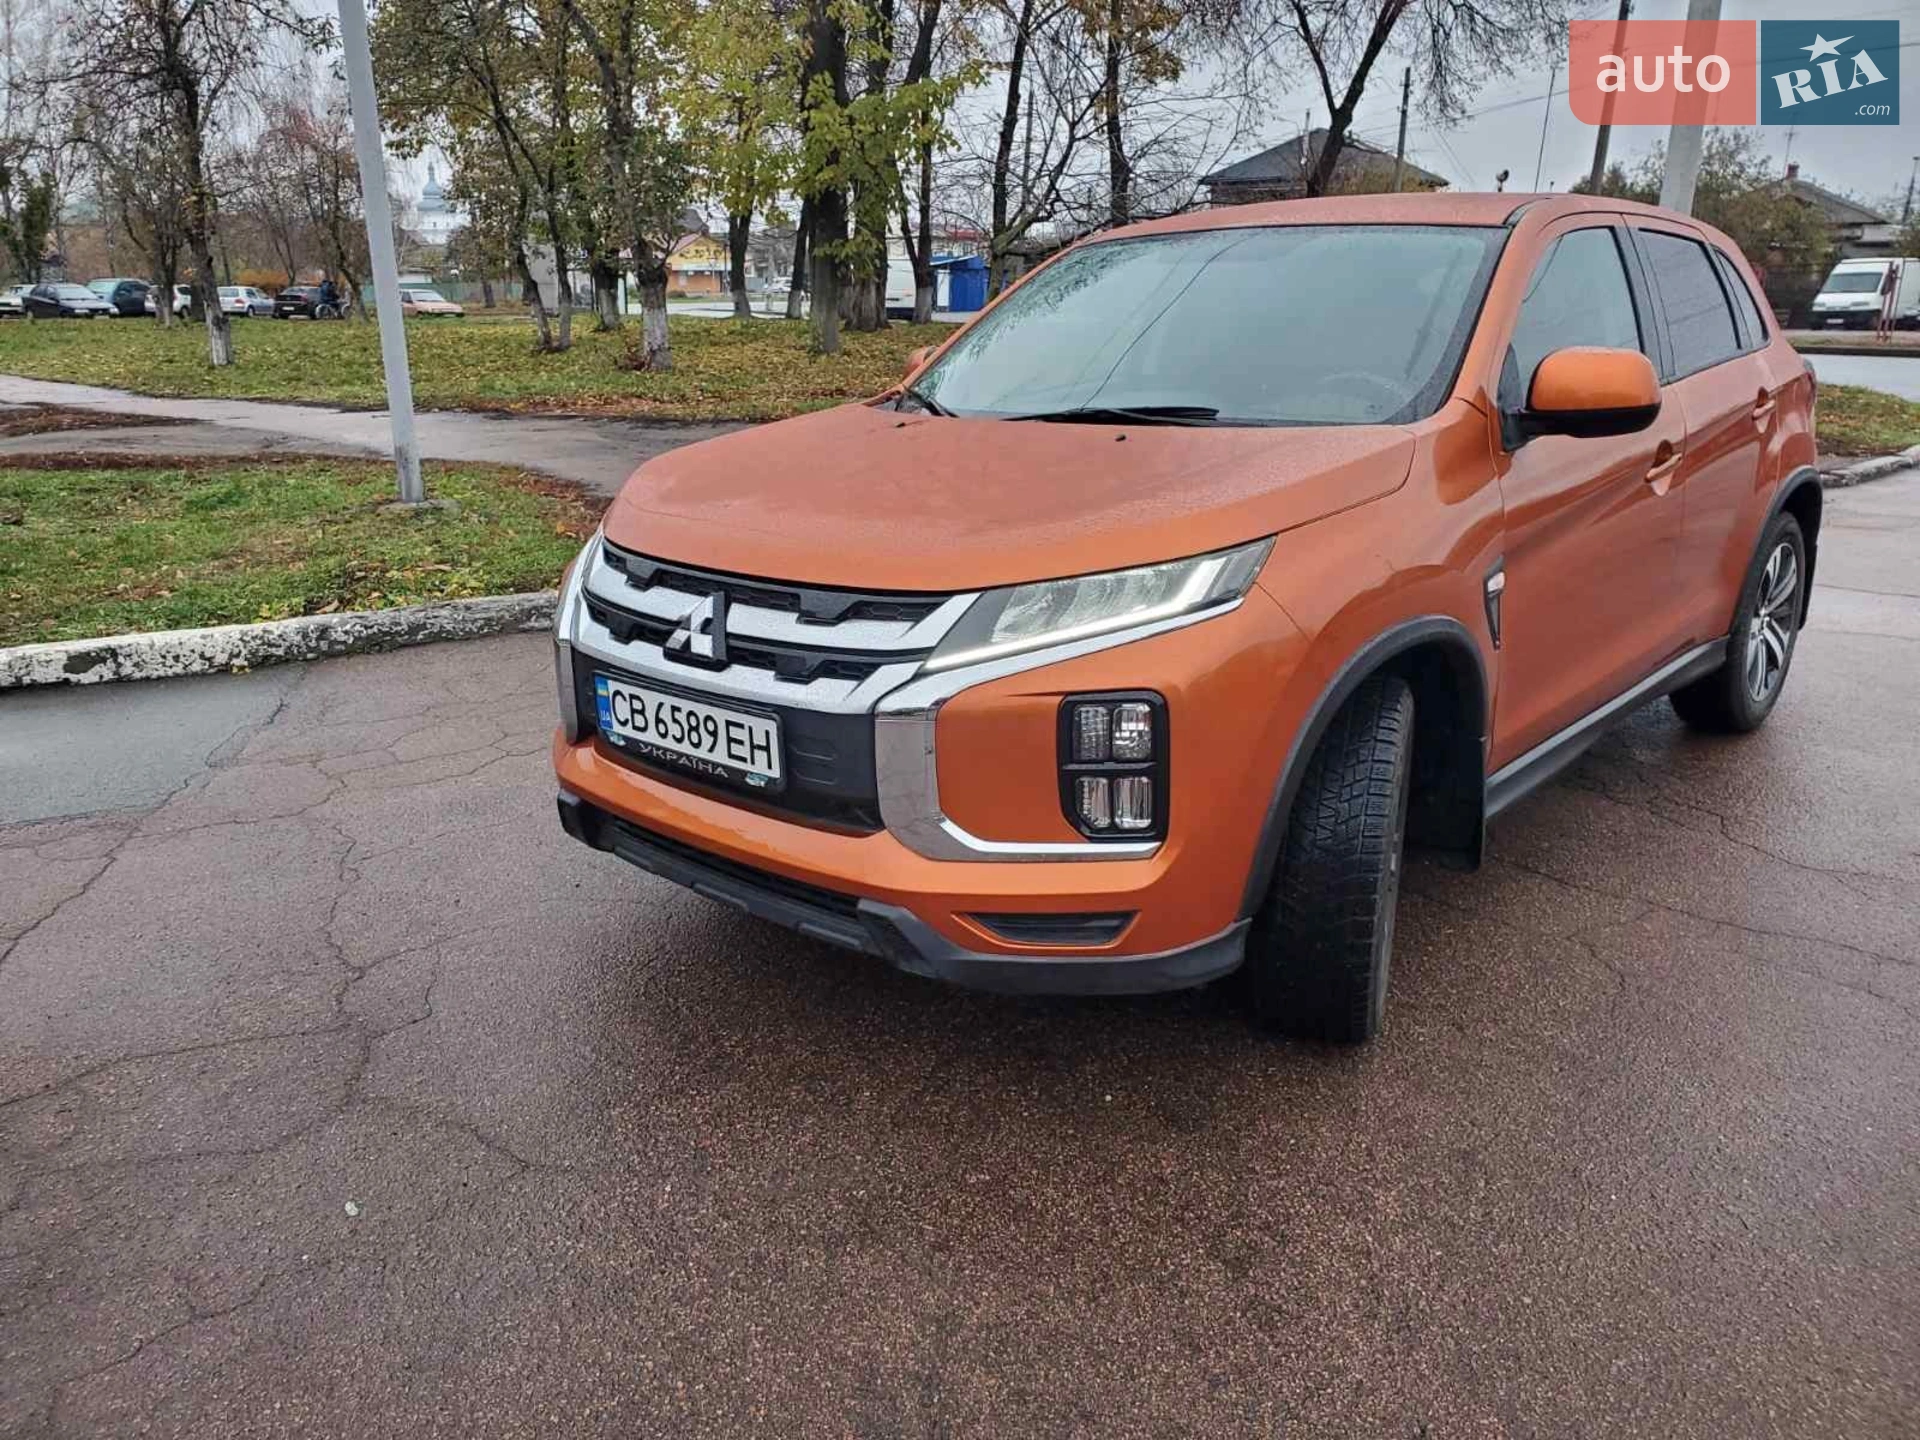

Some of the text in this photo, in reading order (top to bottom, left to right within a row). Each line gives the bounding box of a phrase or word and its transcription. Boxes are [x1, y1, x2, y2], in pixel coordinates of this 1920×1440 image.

[611, 689, 772, 770] CB 6589 EH
